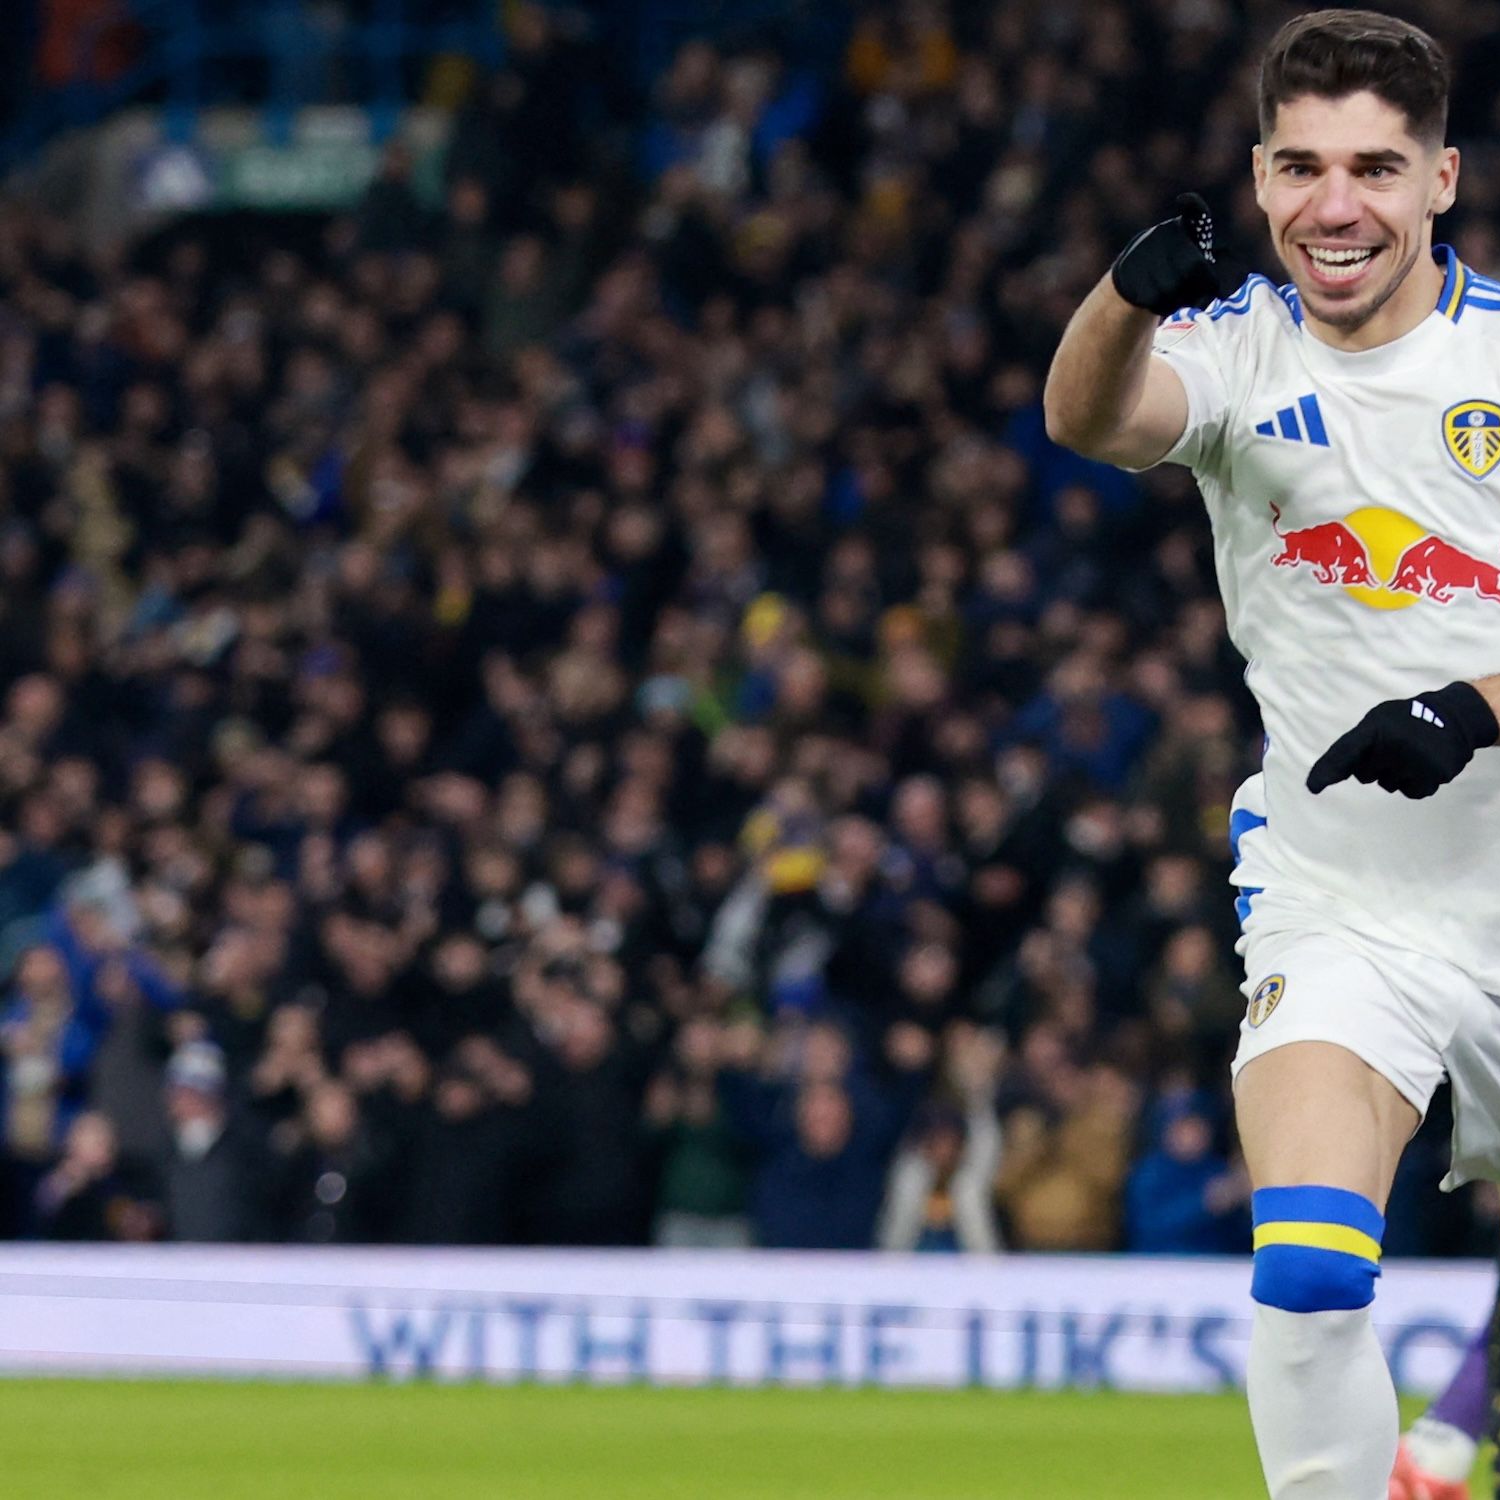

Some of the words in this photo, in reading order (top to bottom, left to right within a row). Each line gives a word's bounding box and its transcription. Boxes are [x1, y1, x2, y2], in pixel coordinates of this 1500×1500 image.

[350, 1298, 652, 1380] WITH
[686, 1300, 920, 1388] THE
[964, 1304, 1242, 1390] UK'S
